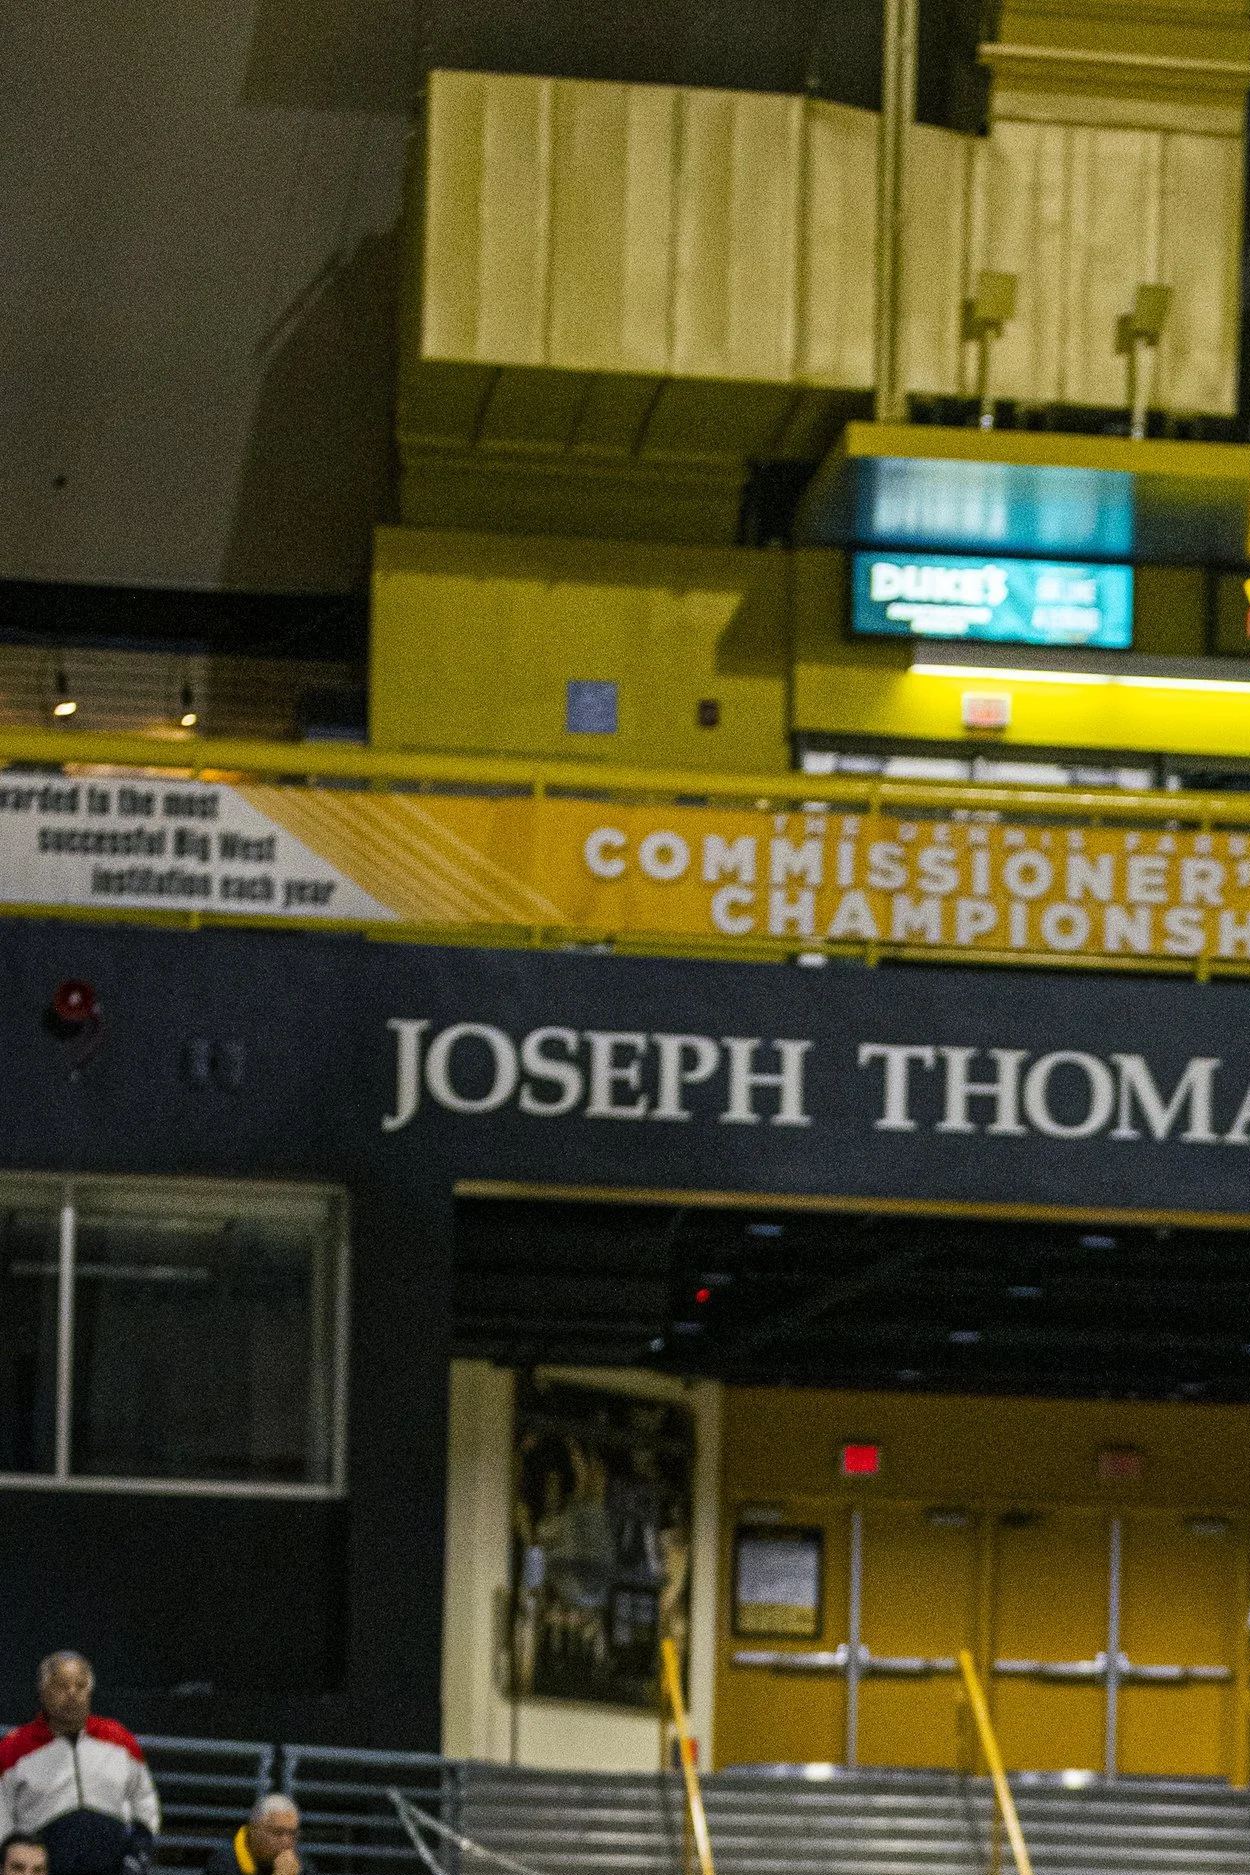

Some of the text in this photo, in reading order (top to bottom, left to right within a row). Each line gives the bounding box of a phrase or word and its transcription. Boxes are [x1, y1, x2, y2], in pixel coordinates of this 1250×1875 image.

[38, 826, 277, 863] successful Big West
[220, 872, 274, 902] each
[283, 879, 337, 907] year
[383, 1018, 812, 1132] JOSEPH
